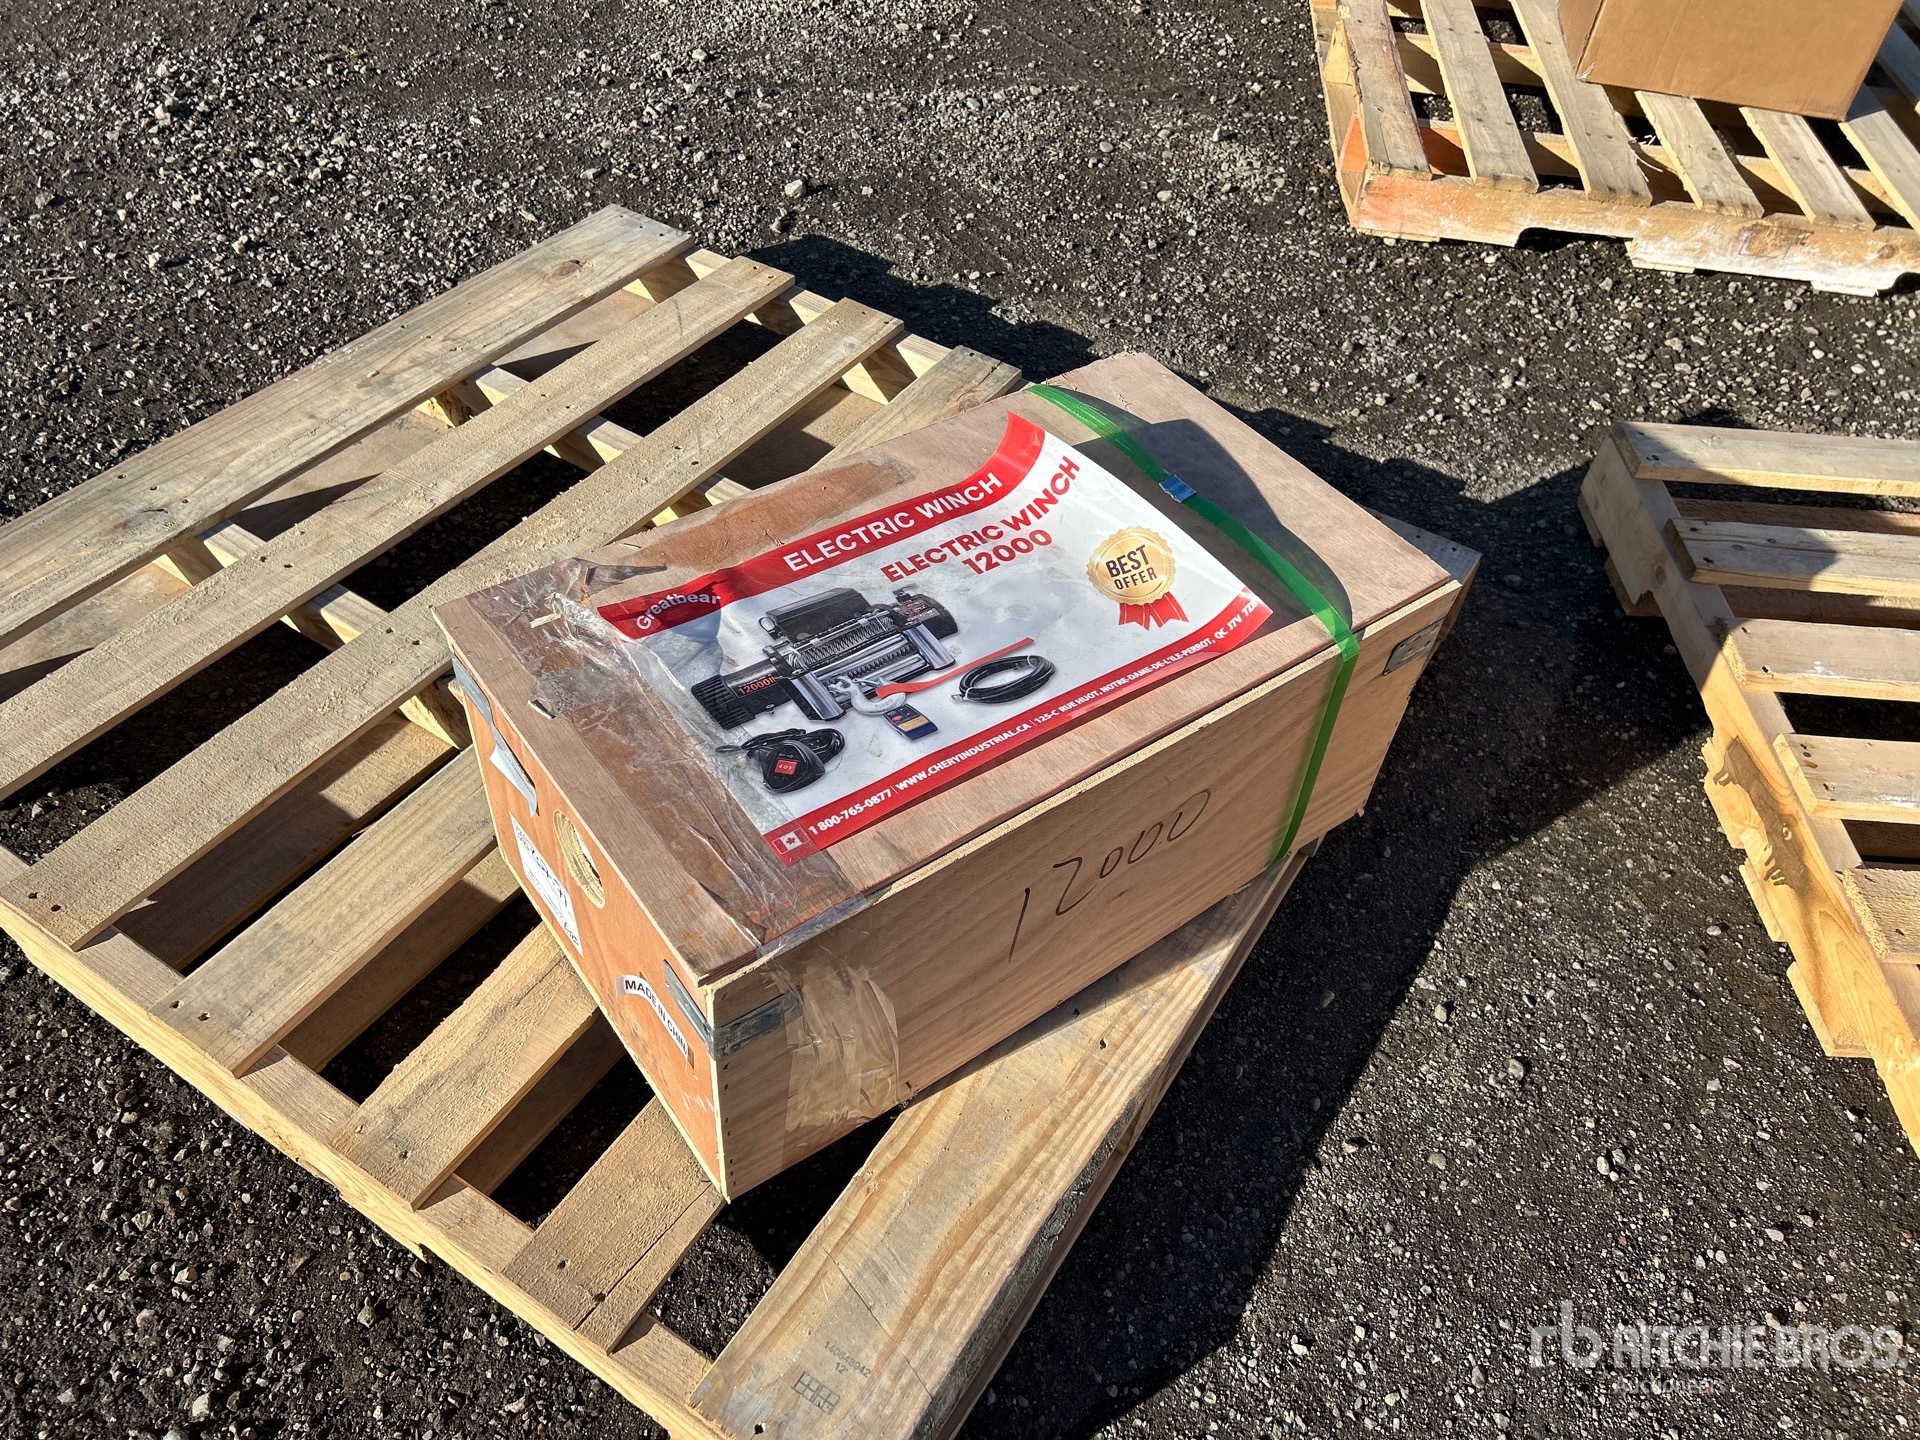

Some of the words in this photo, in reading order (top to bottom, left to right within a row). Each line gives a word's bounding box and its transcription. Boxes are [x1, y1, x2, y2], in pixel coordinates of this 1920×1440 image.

[782, 510, 916, 573] ELECTRIC
[914, 472, 1004, 520] WINCH
[880, 524, 1005, 583] ELECTRIC
[1000, 455, 1081, 534] WINCH
[961, 528, 1053, 576] 12000
[1105, 544, 1151, 578] BEST
[1113, 567, 1158, 590] OFFER
[636, 593, 721, 630] Greatbear
[818, 788, 893, 833] 800-765-0877
[894, 722, 1032, 791] WWW.CHERYINDUSTRIAL.CA
[1058, 697, 1077, 712] RUE
[1213, 626, 1229, 640] QC
[1226, 613, 1243, 631] J7V
[1008, 788, 1211, 963] 12000
[624, 979, 657, 1008] MADE
[656, 1004, 667, 1022] IN
